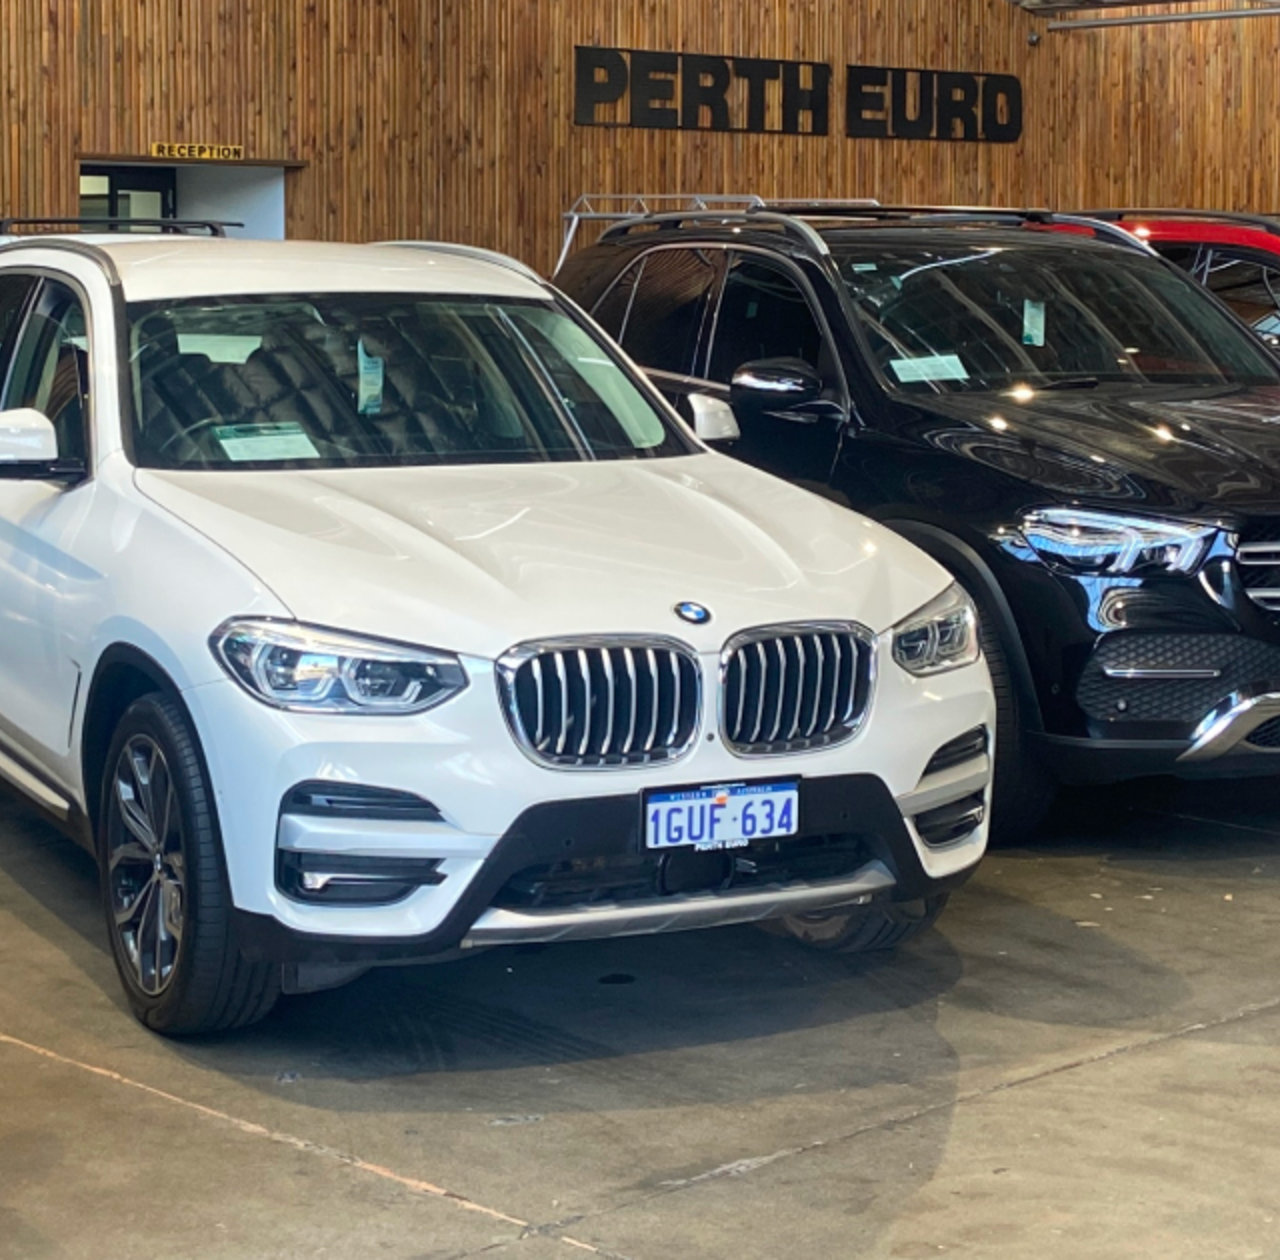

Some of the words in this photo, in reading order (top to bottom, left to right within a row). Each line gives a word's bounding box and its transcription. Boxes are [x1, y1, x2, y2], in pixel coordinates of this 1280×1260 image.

[574, 46, 832, 137] PERTH
[846, 64, 1023, 144] EURO
[157, 144, 242, 159] RECEPTION
